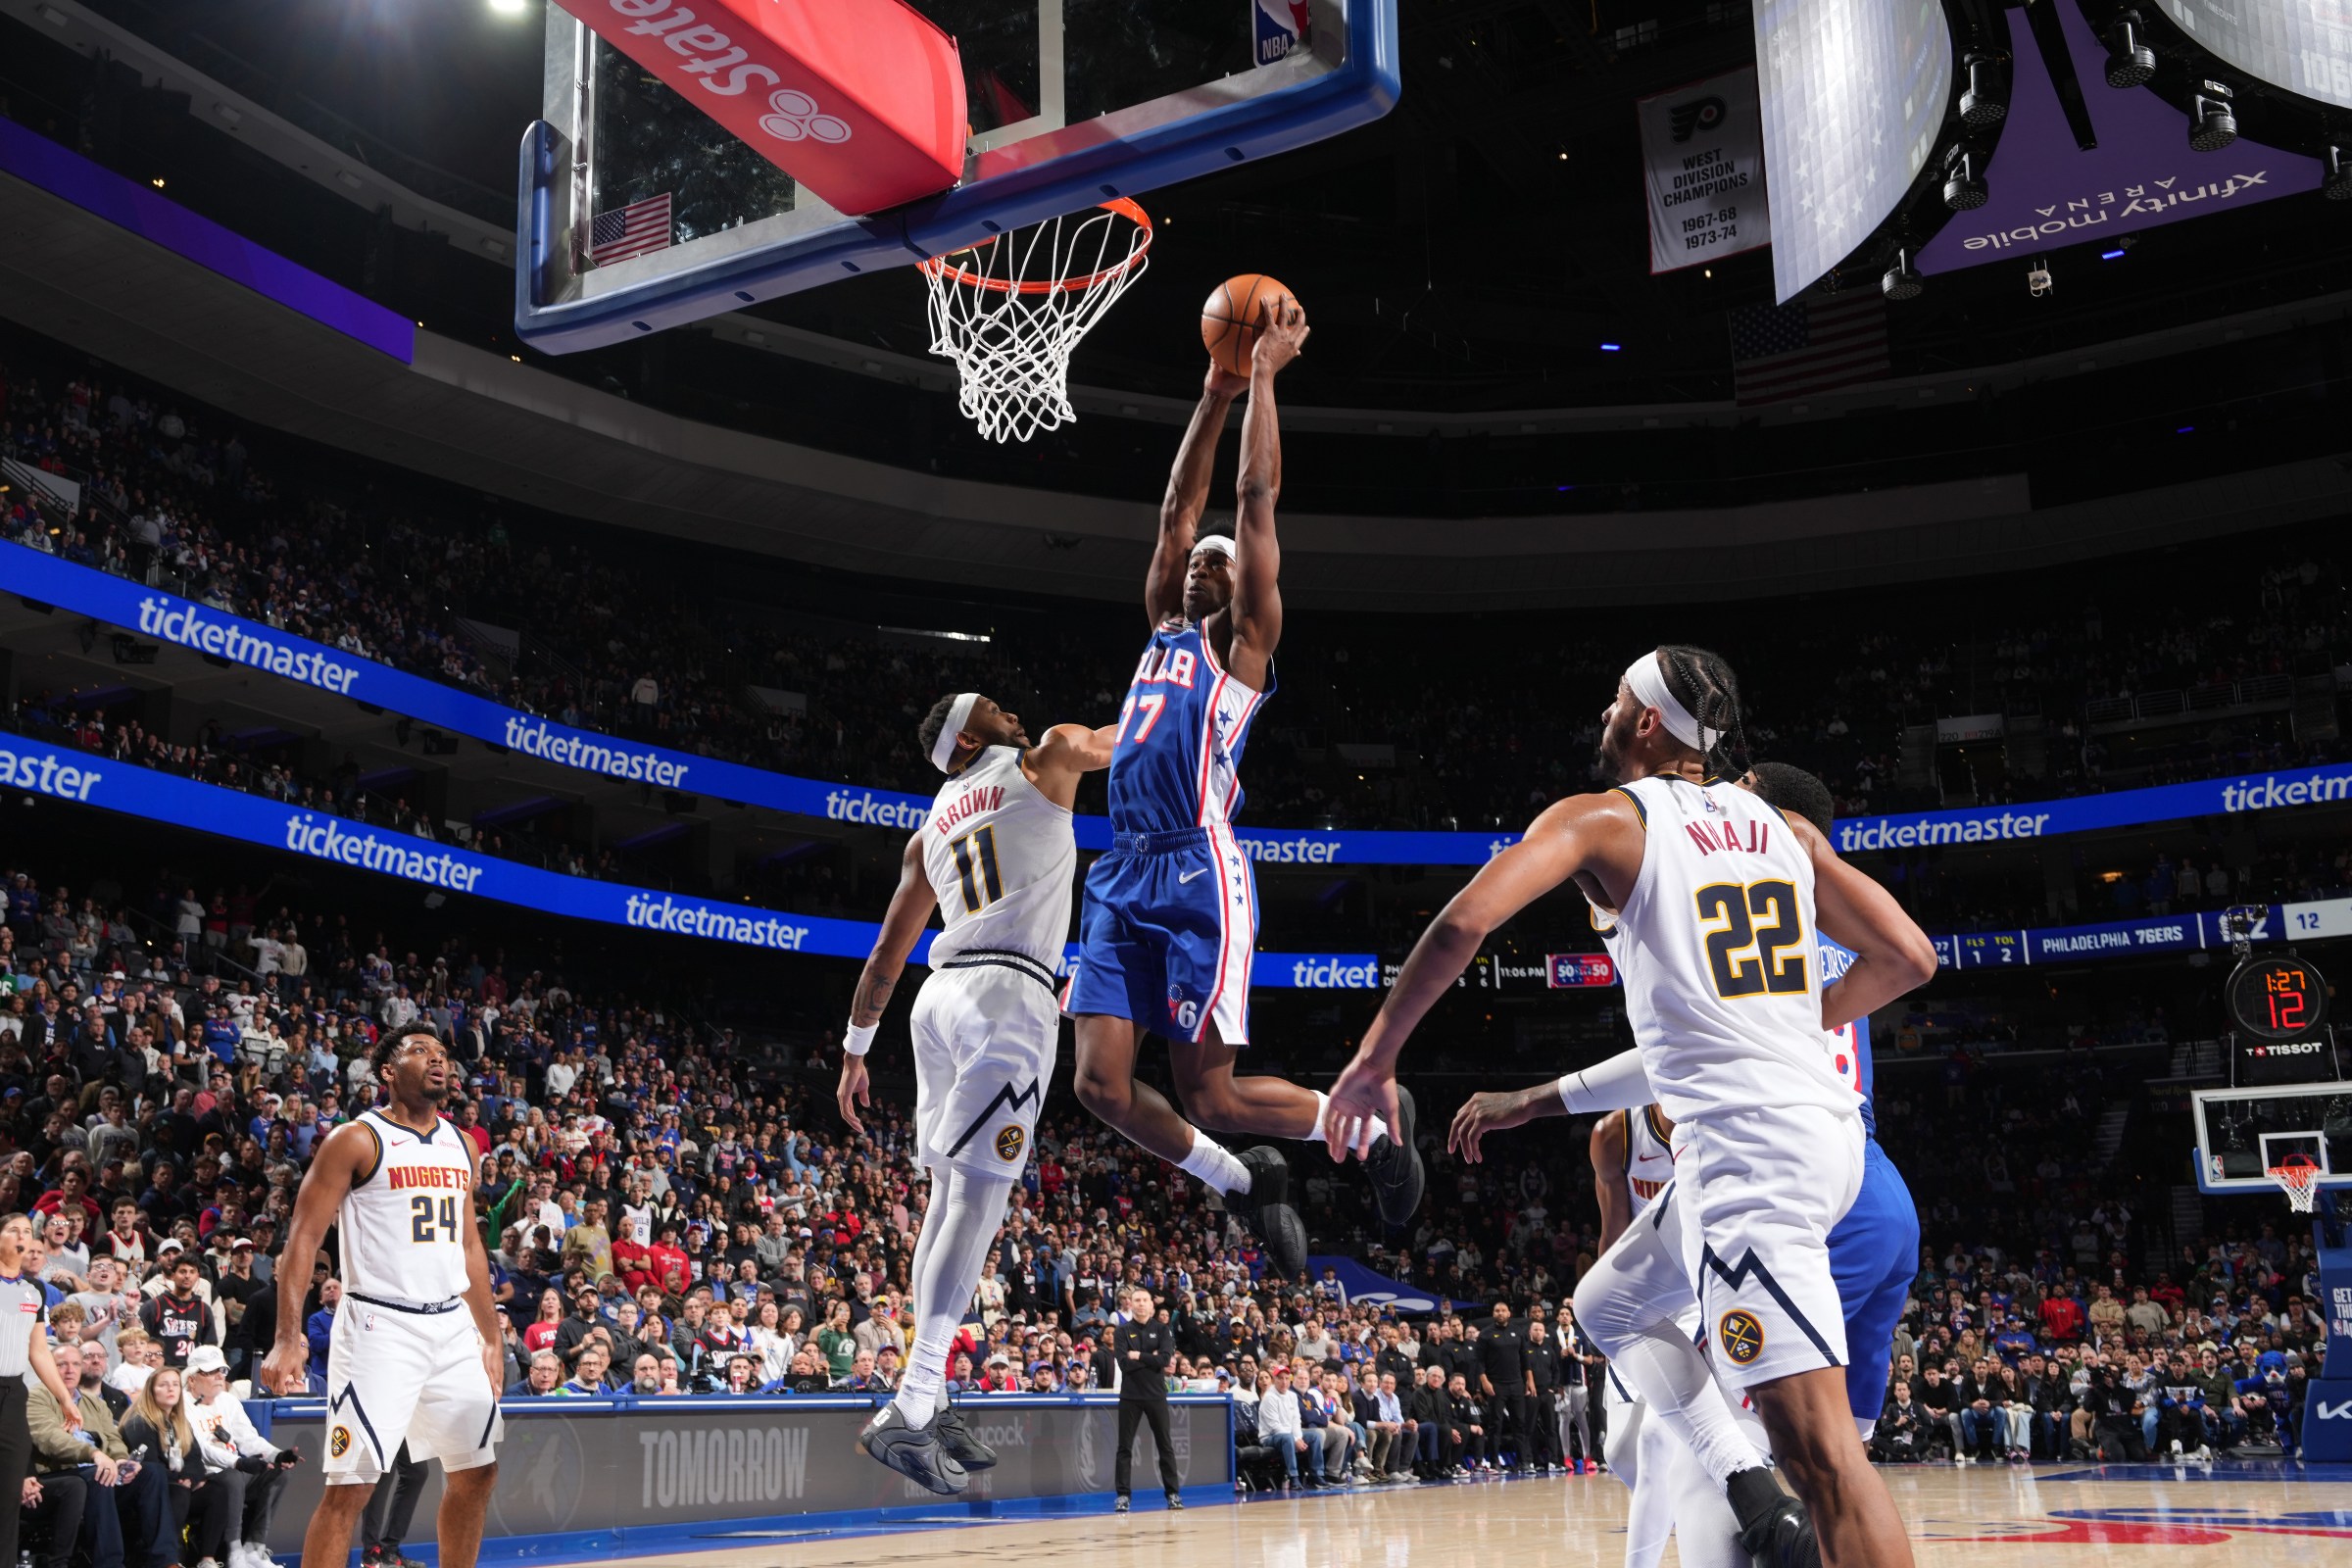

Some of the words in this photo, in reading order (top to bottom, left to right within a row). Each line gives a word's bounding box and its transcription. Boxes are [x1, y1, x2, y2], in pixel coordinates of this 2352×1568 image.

[1262, 33, 1290, 60] NBA
[1673, 160, 1735, 189] DIVISION
[1683, 148, 1722, 171] WEST
[1663, 172, 1748, 207] CHAMPIONS
[2034, 175, 2177, 217] ARENA
[2121, 171, 2268, 217] xfinity
[1682, 206, 1737, 233] 1967-68
[1685, 223, 1738, 250] 1973-74
[1963, 209, 2108, 250] mobile
[138, 596, 360, 694] ticketmaster
[1114, 693, 1166, 744] 77
[506, 716, 689, 787] ticketmaster
[0, 750, 103, 802] aster
[935, 786, 1005, 836] BROWN
[1839, 810, 2050, 852] ticketmaster
[286, 813, 483, 893] ticketmaster
[950, 824, 1005, 915] 11
[625, 893, 809, 951] ticketmaster
[2042, 930, 2132, 954] PHILADELPHIA
[2135, 924, 2184, 946] 76ERS
[2296, 912, 2321, 930] 12
[1693, 878, 1809, 1001] 22
[1966, 938, 1985, 948] FLS
[1994, 935, 2016, 947] TOL
[2001, 948, 2013, 962] 2
[1293, 957, 1379, 989] ticket
[1499, 966, 1527, 978] 11:06
[1528, 966, 1545, 978] PM
[2265, 970, 2306, 993] 1:27
[2268, 992, 2306, 1029] 12
[2266, 1042, 2323, 1056] TISSOT
[387, 1165, 469, 1192] NUGGETS
[412, 1195, 457, 1244] 24
[175, 1341, 196, 1356] 20
[639, 1427, 809, 1509] TOMORROW
